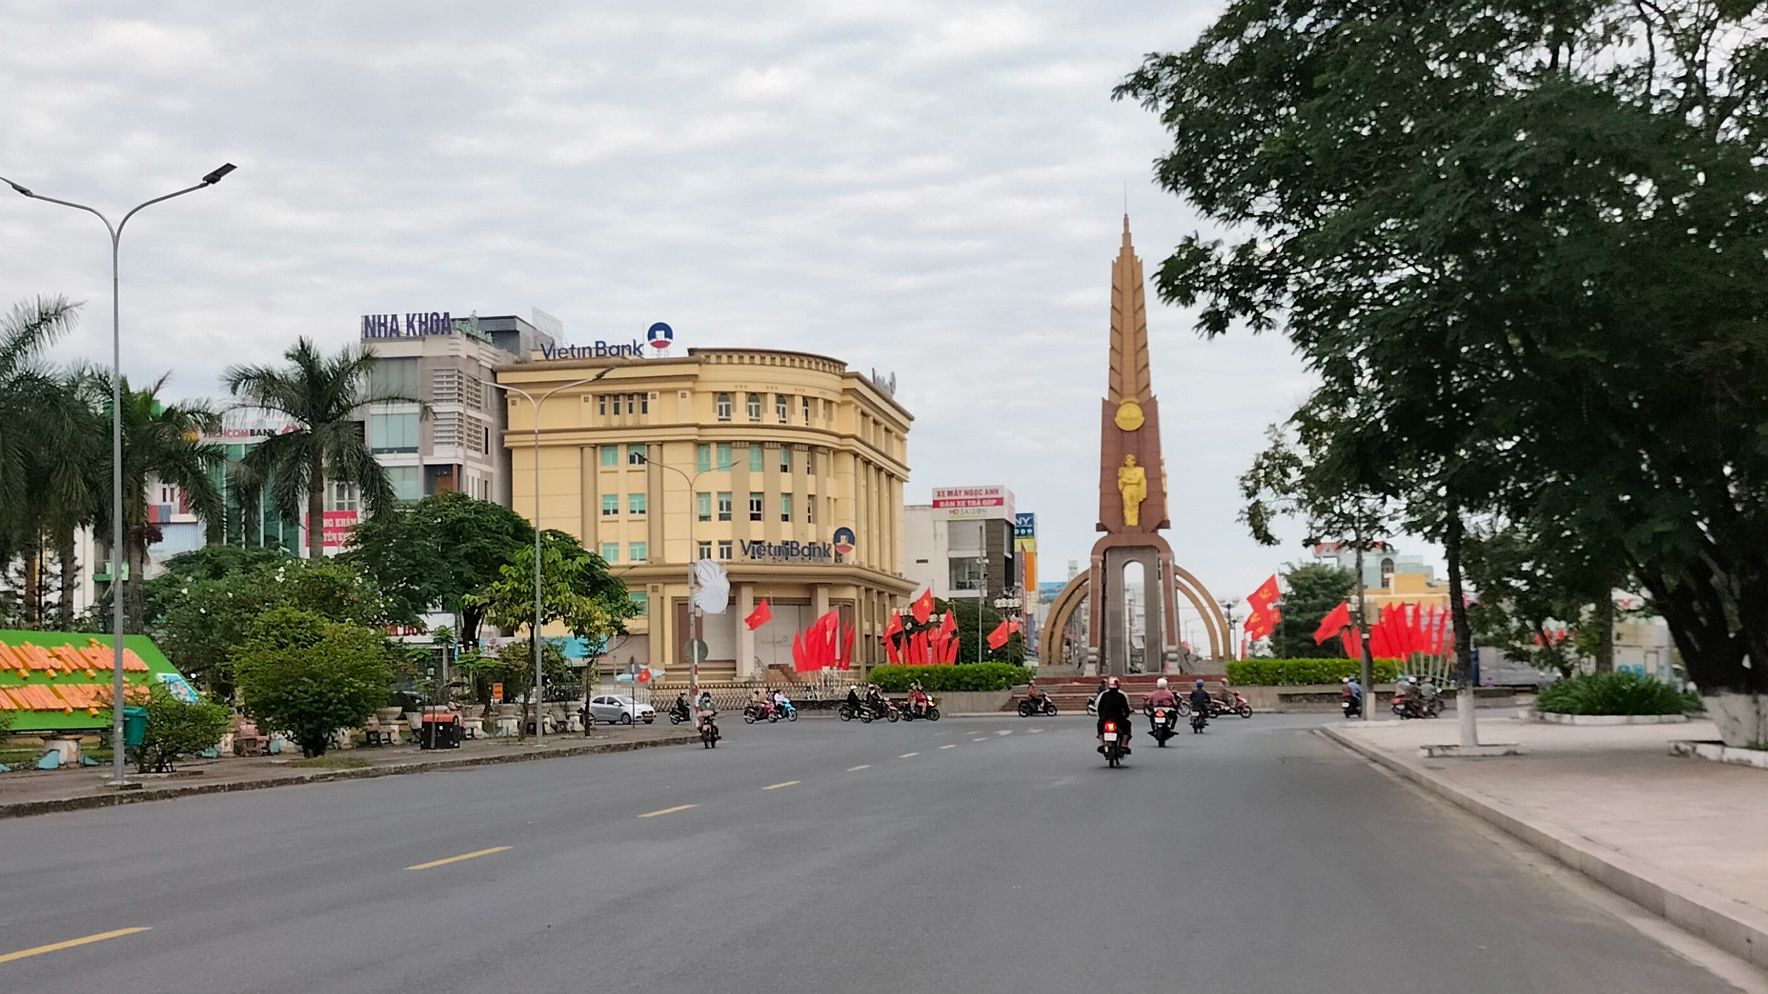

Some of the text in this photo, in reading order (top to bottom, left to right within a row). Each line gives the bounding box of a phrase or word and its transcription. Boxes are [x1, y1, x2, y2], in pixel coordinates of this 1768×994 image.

[364, 314, 401, 338] NHA
[406, 311, 453, 336] KHOA
[540, 339, 644, 361] VietinBank
[937, 488, 999, 499] XE MÁY NGỌC ANH
[939, 499, 956, 508] BÁN
[739, 538, 831, 558] VietinBank
